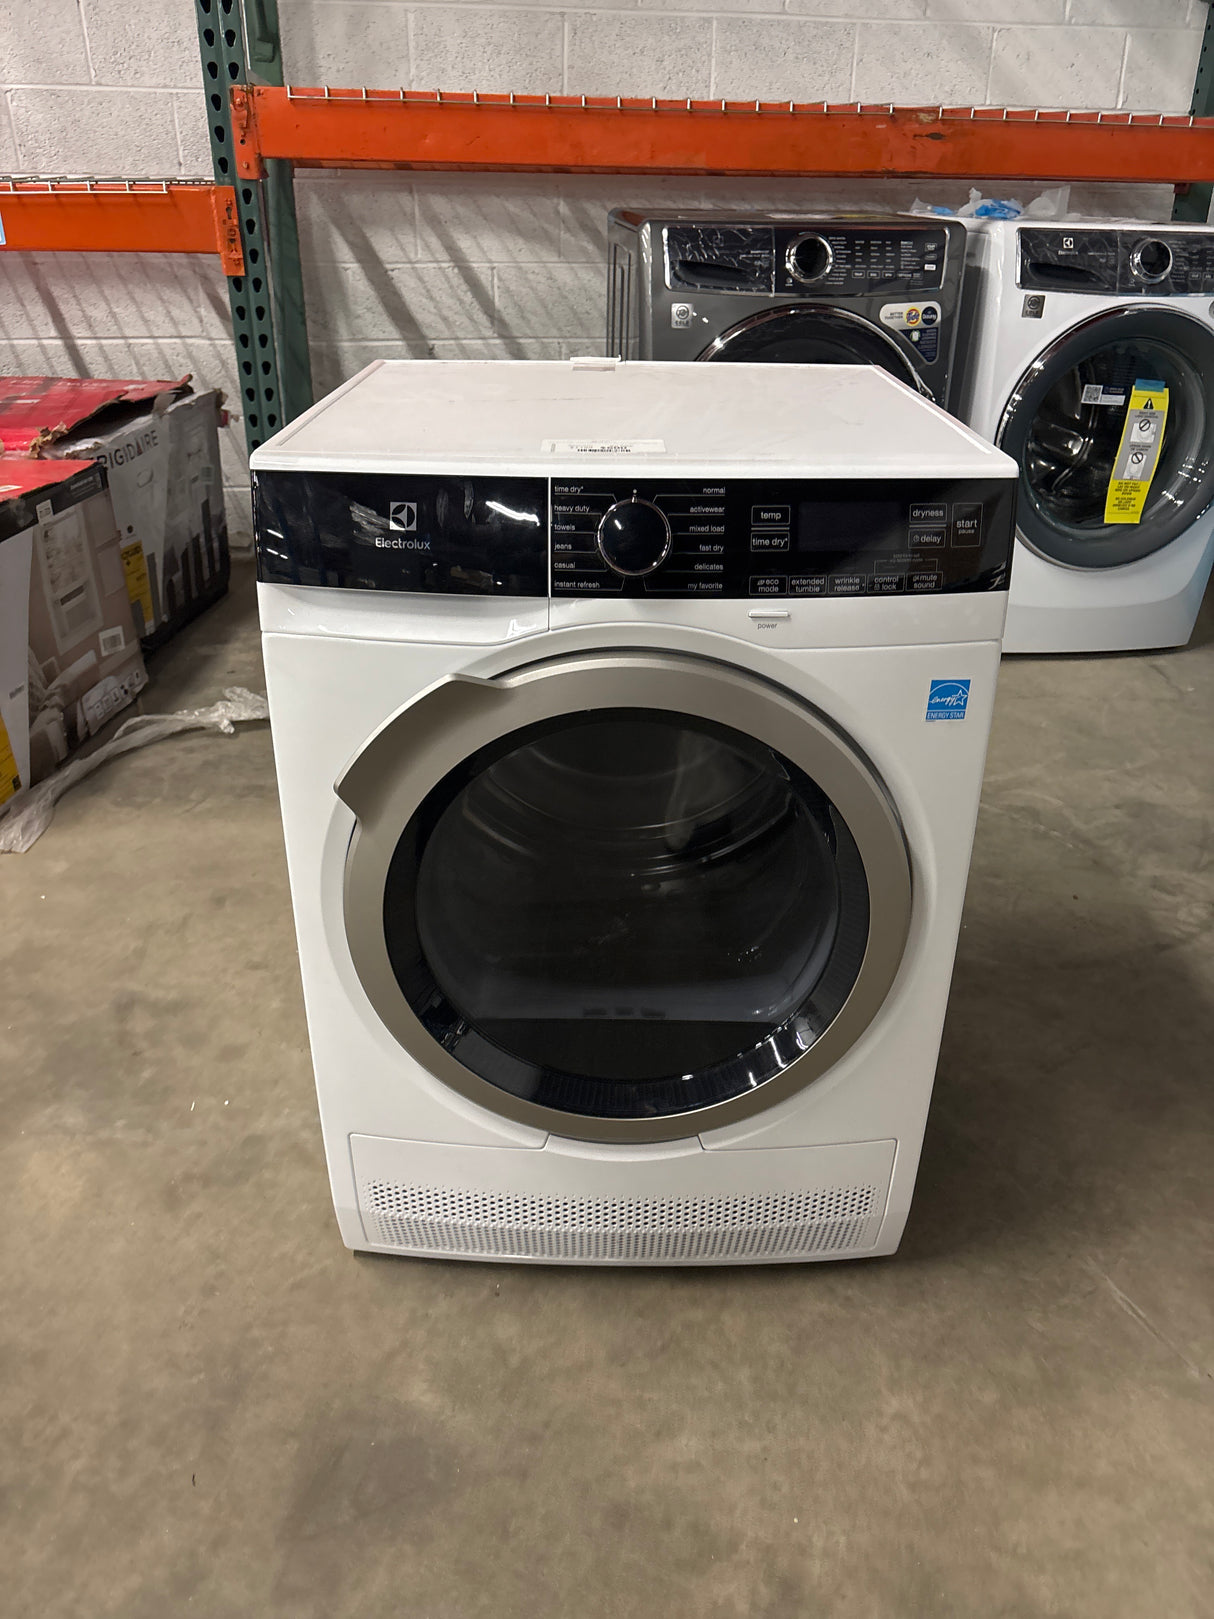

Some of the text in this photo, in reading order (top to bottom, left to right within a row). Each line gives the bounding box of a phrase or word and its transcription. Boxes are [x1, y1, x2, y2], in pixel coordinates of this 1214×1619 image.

[554, 485, 569, 493] time
[554, 505, 590, 513] heavy duty
[912, 508, 944, 518] dryness
[760, 511, 782, 521] temp
[554, 523, 576, 531] towels
[956, 519, 978, 529] start
[375, 537, 431, 550] Electrolux
[752, 537, 770, 546] time
[920, 535, 942, 545] delay
[554, 543, 572, 551] jeans
[713, 544, 724, 553] dry
[694, 563, 724, 571] delicates
[791, 577, 825, 585] extended
[834, 576, 860, 585] wrinkle
[874, 575, 899, 583] control
[920, 573, 938, 582] mute
[577, 581, 600, 589] refresh
[795, 584, 820, 593] tumble
[882, 583, 897, 591] lock
[913, 580, 936, 589] sound
[758, 585, 779, 593] mode
[757, 622, 778, 630] power
